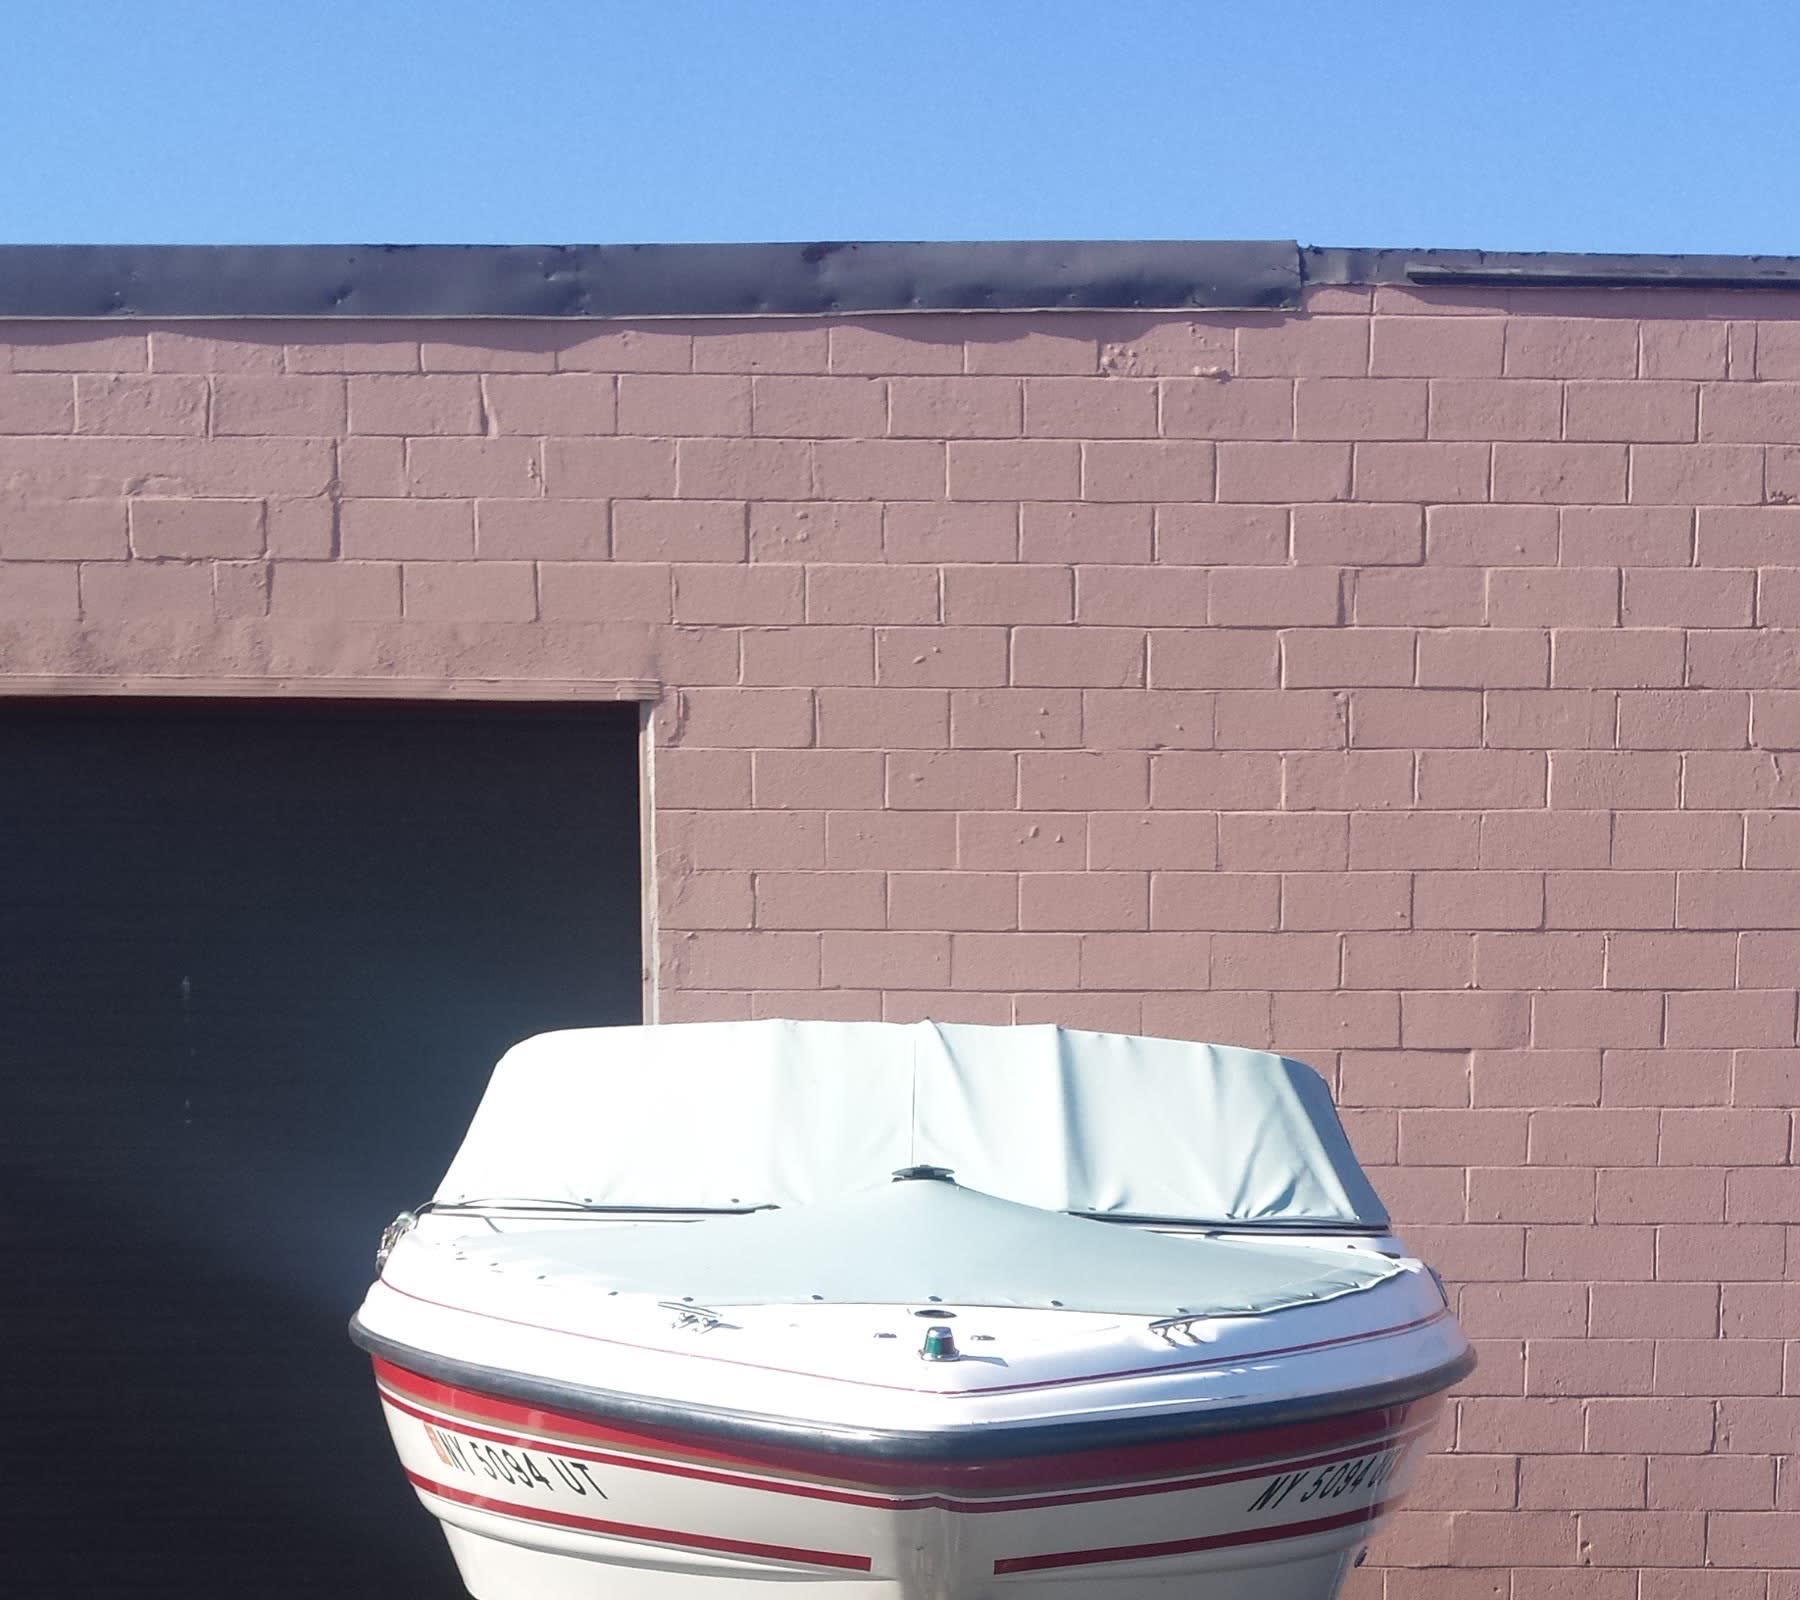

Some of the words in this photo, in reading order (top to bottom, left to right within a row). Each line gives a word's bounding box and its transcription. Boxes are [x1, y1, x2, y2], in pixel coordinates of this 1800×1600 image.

[436, 1430, 476, 1476] NY
[469, 1441, 554, 1491] 5094
[547, 1456, 608, 1500] UT
[1246, 1471, 1310, 1512] NY
[1300, 1455, 1377, 1502] 5094
